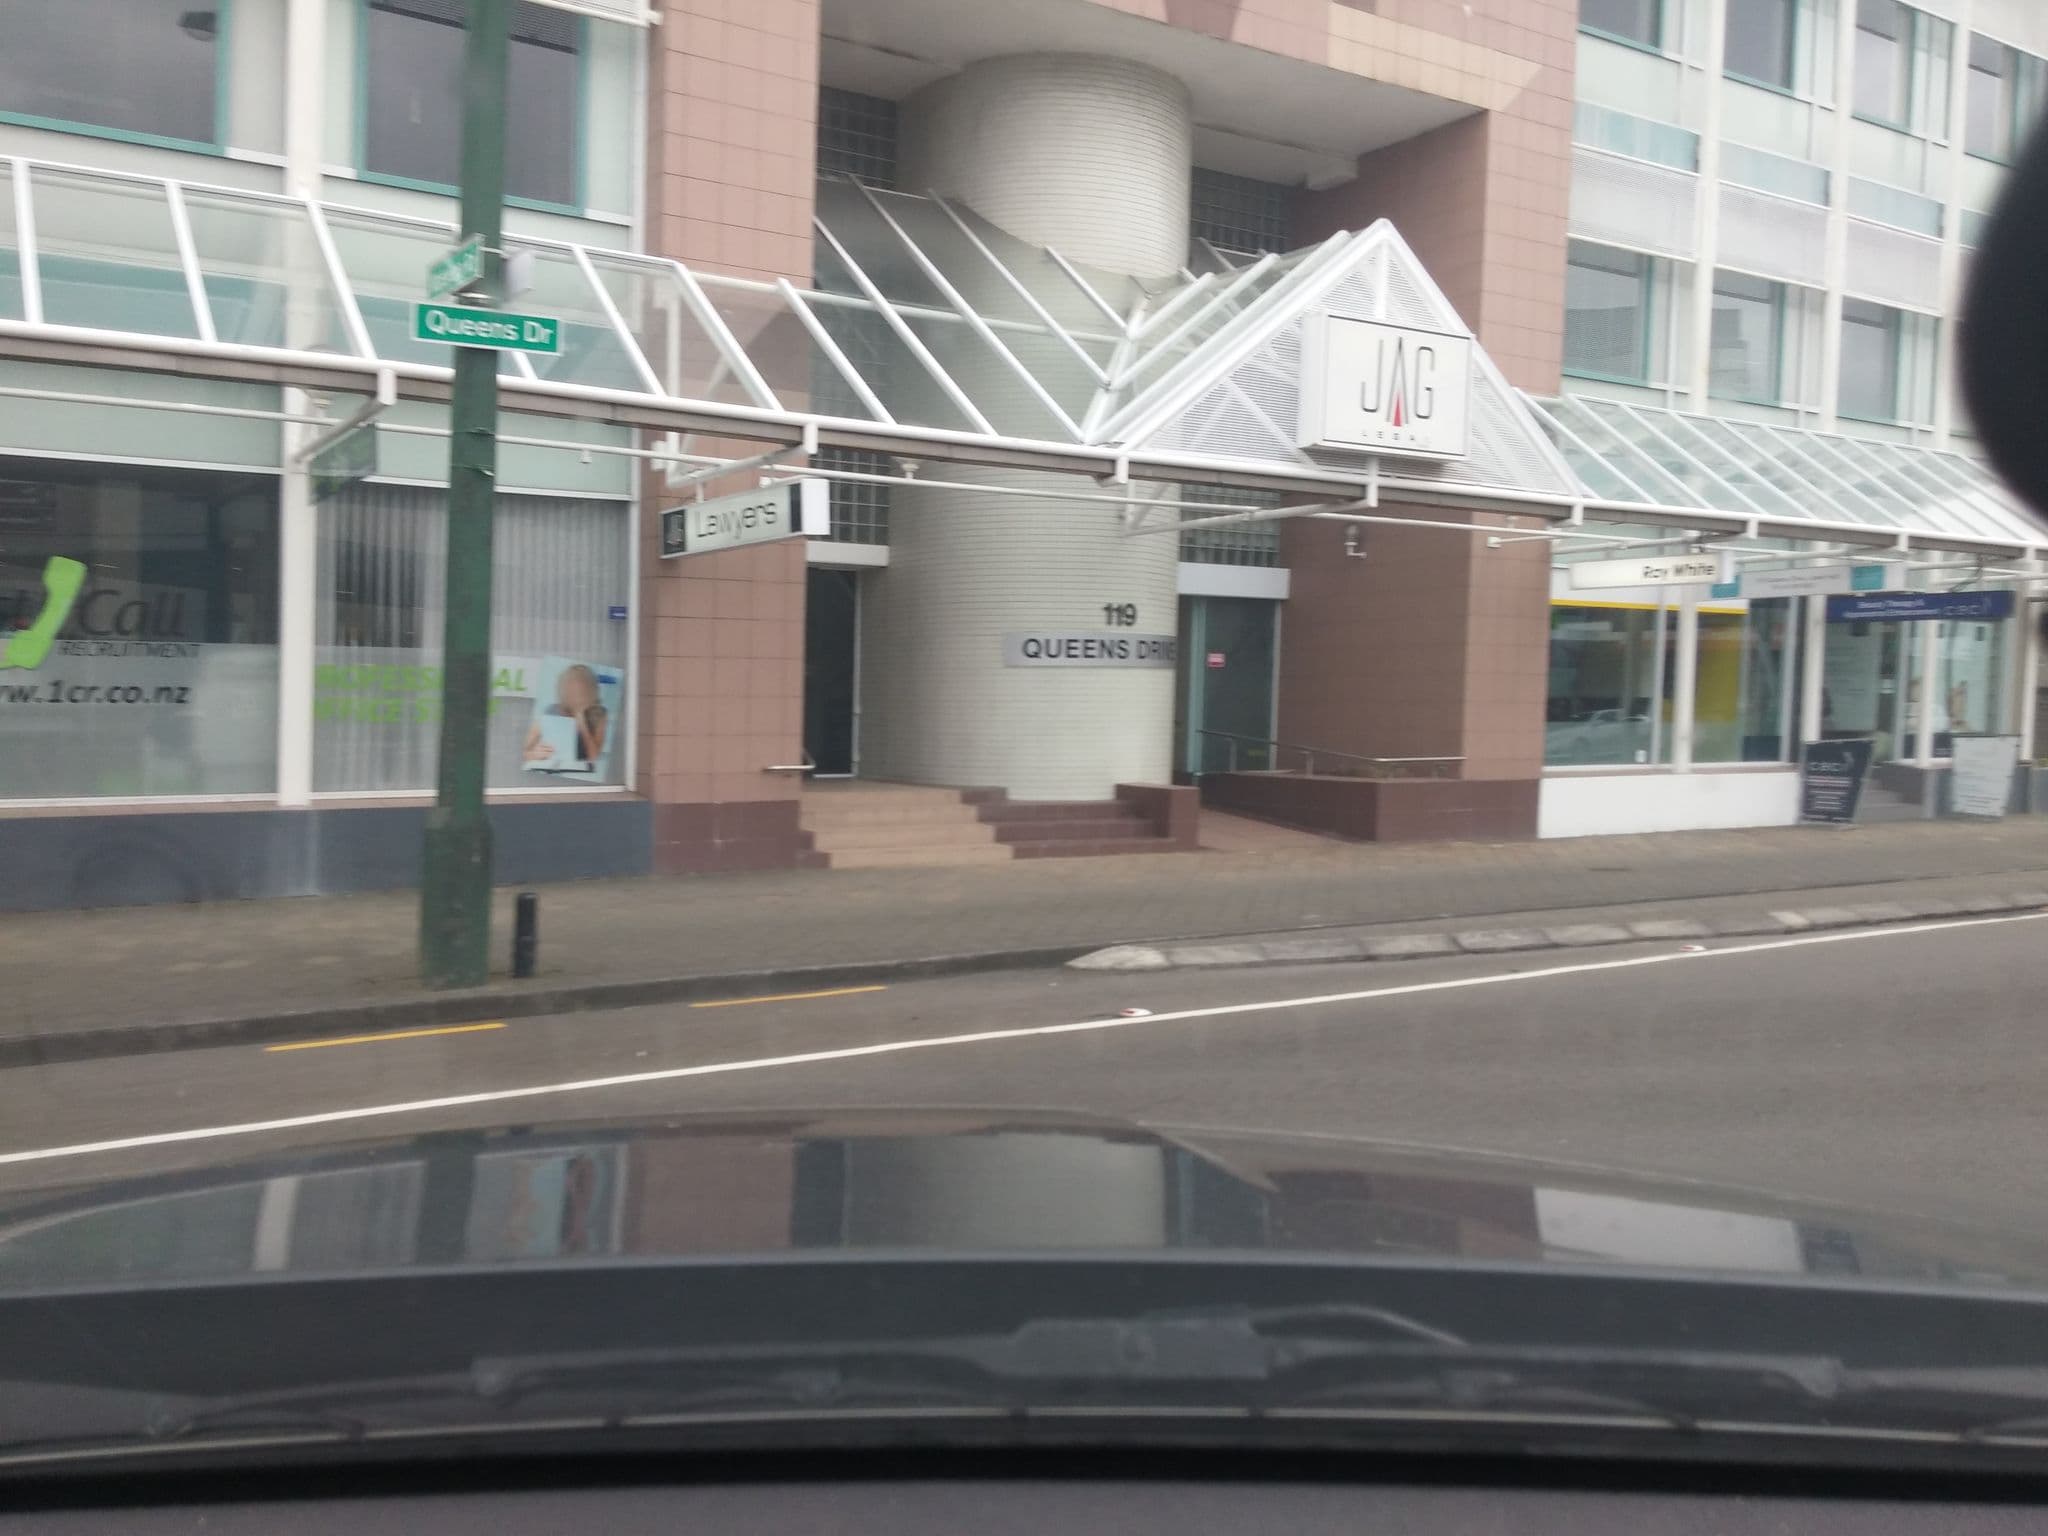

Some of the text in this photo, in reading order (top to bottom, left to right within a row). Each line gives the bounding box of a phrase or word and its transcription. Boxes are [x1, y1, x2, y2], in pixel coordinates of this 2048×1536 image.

[425, 309, 553, 344] Queens Dr
[1360, 336, 1435, 426] JAG
[694, 502, 778, 540] Lawyers
[1642, 563, 1715, 579] Ray White
[1101, 602, 1138, 627] 119
[1020, 637, 1130, 660] QUEENS
